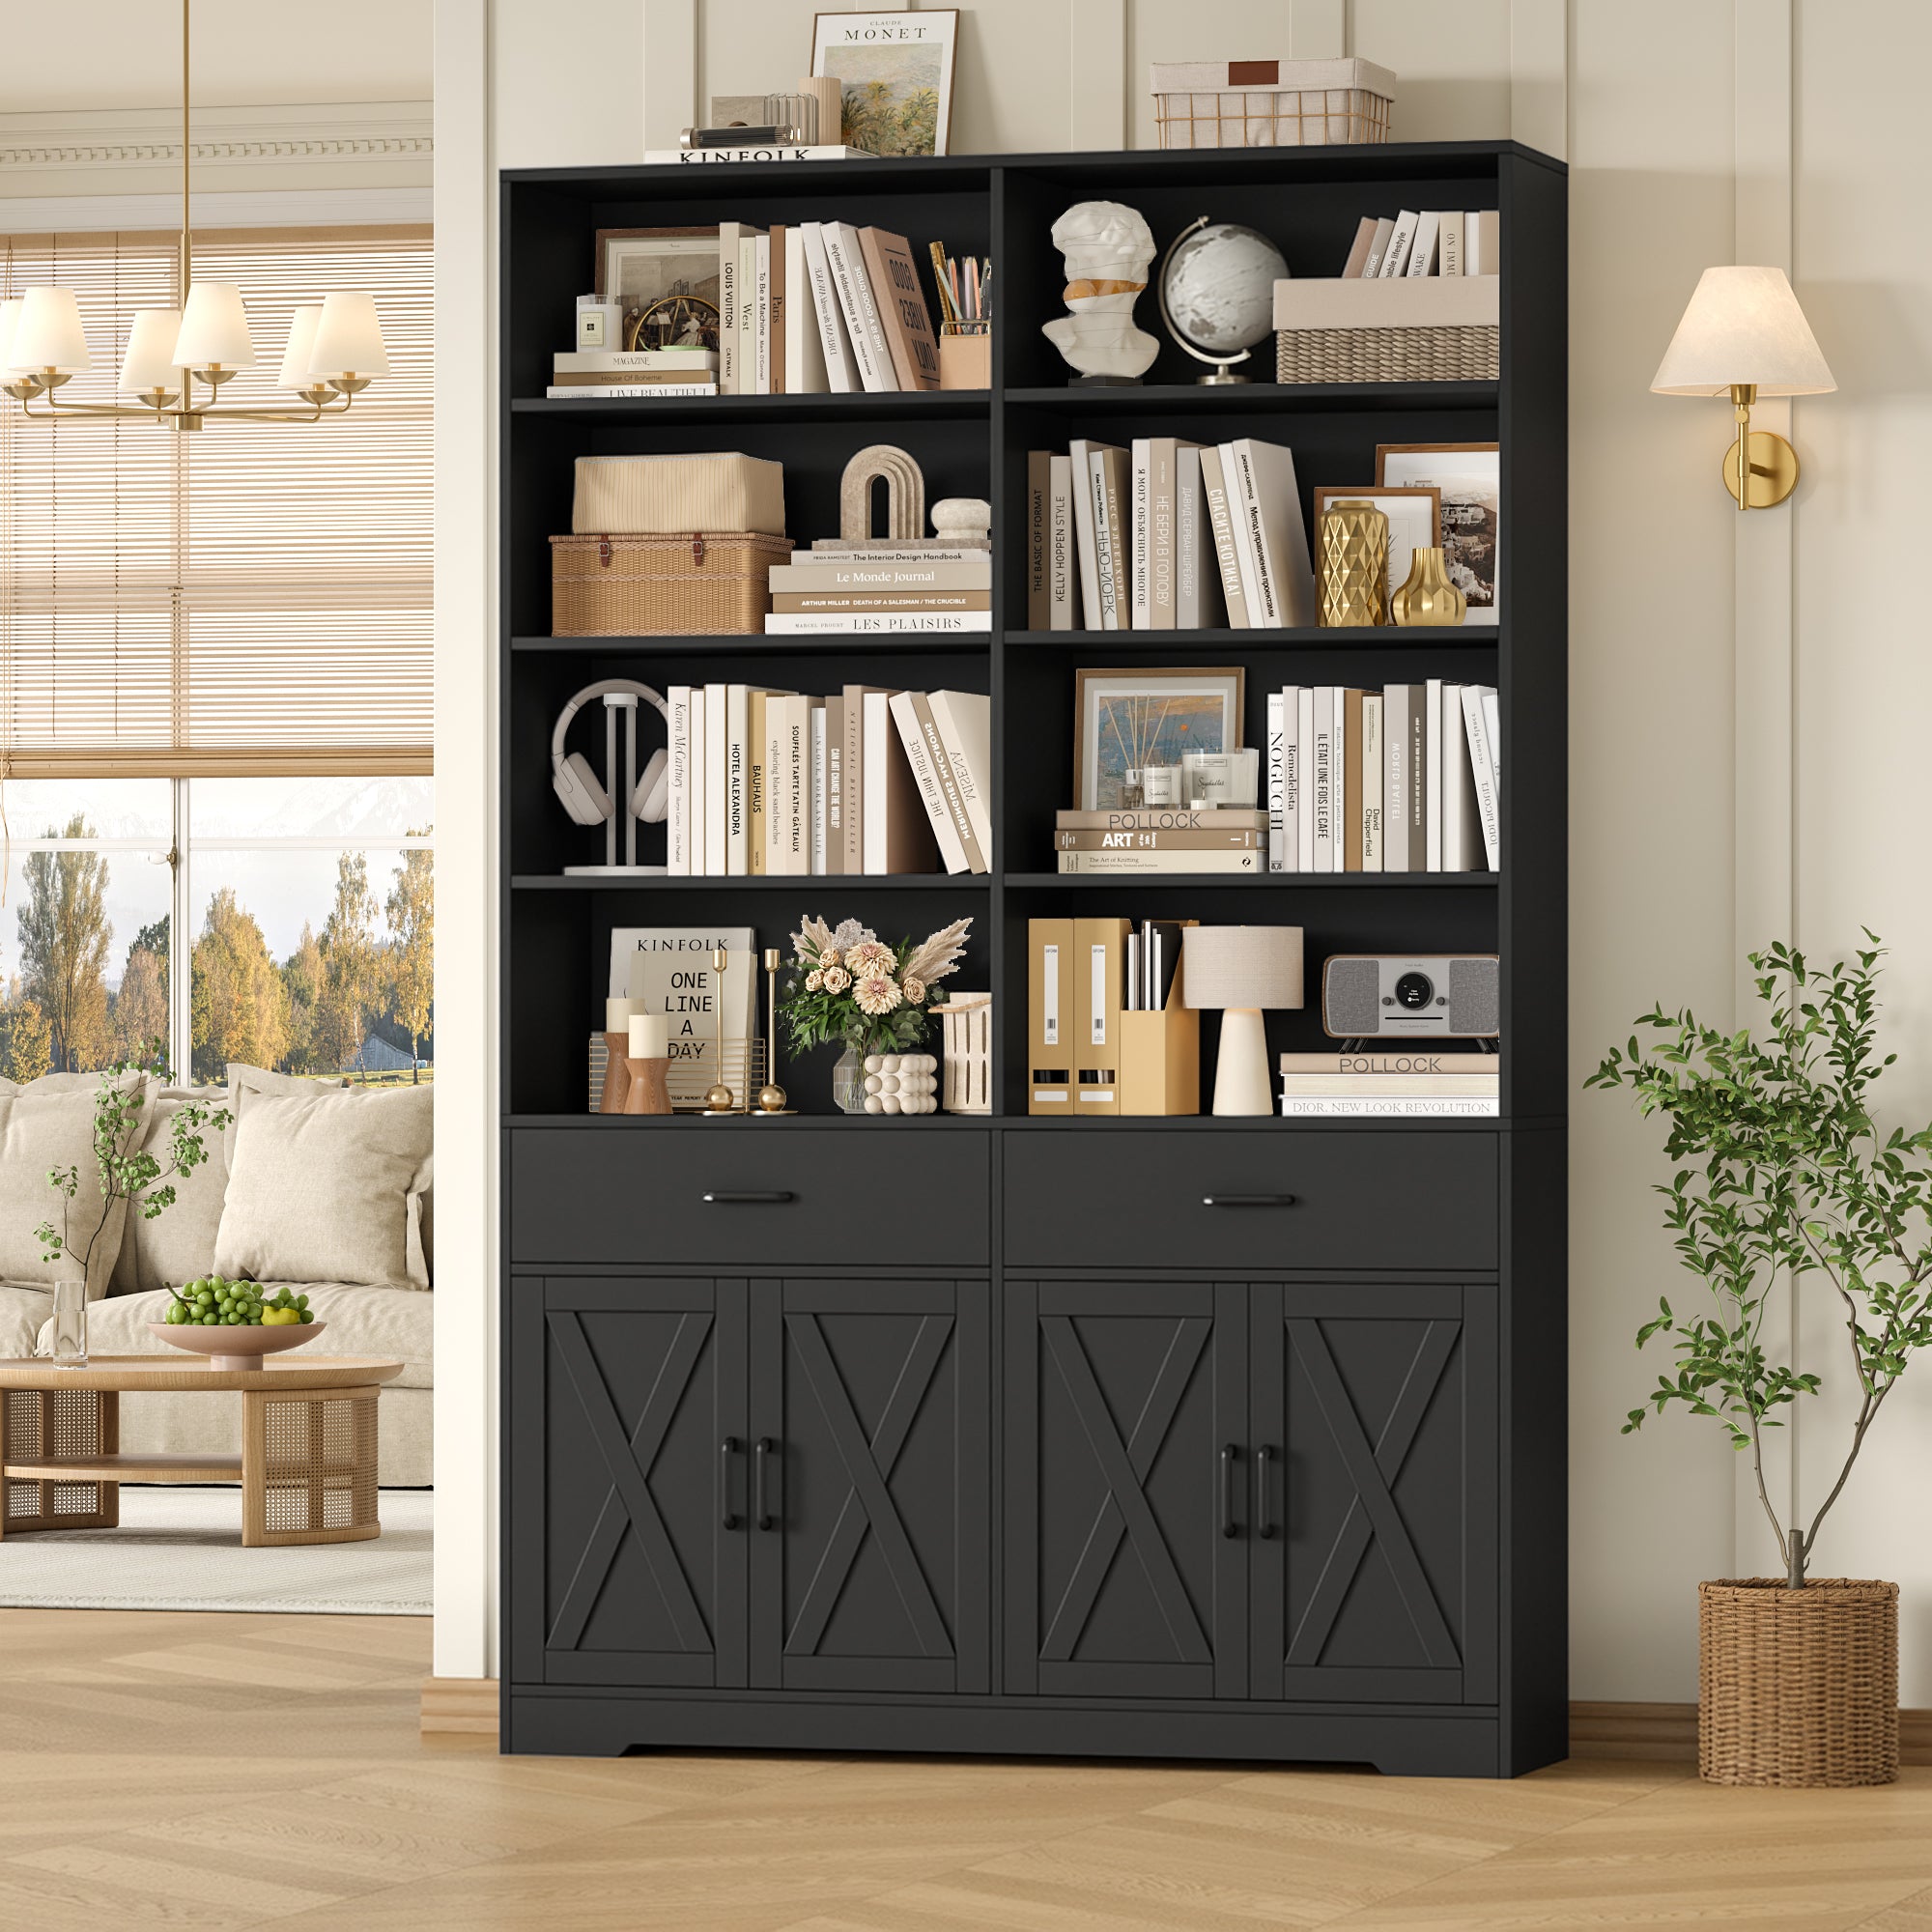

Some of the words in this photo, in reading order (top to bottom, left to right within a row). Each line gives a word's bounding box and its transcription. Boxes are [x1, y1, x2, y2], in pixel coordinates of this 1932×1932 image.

[844, 27, 927, 41] MONET
[1391, 232, 1406, 260] lifestyle
[1447, 233, 1455, 245] ON
[1366, 254, 1379, 277] GUIDE
[759, 272, 766, 281] To
[759, 283, 766, 295] Be
[742, 303, 752, 330] West
[773, 297, 782, 324] Paris
[612, 357, 650, 366] MAGAZINE
[1056, 497, 1065, 526] STYLE
[1157, 496, 1169, 510] НЕ
[1181, 487, 1191, 520] ДАВИД
[1035, 530, 1042, 542] OF
[1157, 515, 1169, 545] БЕРИ
[1056, 529, 1065, 571] HOPPEN
[1209, 489, 1231, 542] СПАСИТЕ
[1220, 544, 1240, 596] КОТИКА!
[895, 554, 922, 562] Design
[1157, 548, 1169, 556] В
[1113, 526, 1124, 600] ЭЛЛЕНХОРН
[837, 573, 850, 582] Le
[853, 572, 892, 582] Monde
[894, 571, 935, 583] Journal
[1097, 530, 1115, 614] НЬЮ-ЙОРК
[1056, 572, 1065, 602] KELLY
[1157, 559, 1169, 607] ГОЛОВУ
[854, 618, 881, 630] LES
[889, 618, 962, 629] PLAISIRS
[675, 703, 686, 731] Karen
[672, 735, 686, 788] McCartney
[770, 740, 779, 774] exploring
[831, 748, 840, 761] CAN
[1318, 745, 1329, 765] ÉTAIT
[831, 771, 840, 790] CHANGE
[1270, 732, 1283, 831] NOGUCHI
[1288, 745, 1297, 810] Remodelista
[1318, 768, 1327, 784] UNE
[753, 765, 761, 813] BAUHAUS
[831, 791, 840, 801] THE
[1318, 786, 1327, 805] FOIS
[1318, 807, 1327, 816] LE
[1109, 813, 1201, 830] POLLOCK
[1318, 818, 1329, 838] CAFÉ
[1102, 833, 1134, 847] ART
[638, 939, 728, 952] KINFOLK
[670, 972, 707, 988] ONE
[665, 996, 713, 1011] LINE
[680, 1020, 694, 1036] A
[668, 1042, 706, 1059] DAY
[1339, 1057, 1441, 1073] POLLOCK
[1332, 1103, 1361, 1113] NEW
[1365, 1103, 1401, 1113] LOOK
[1406, 1103, 1491, 1113] REVOLUTION
